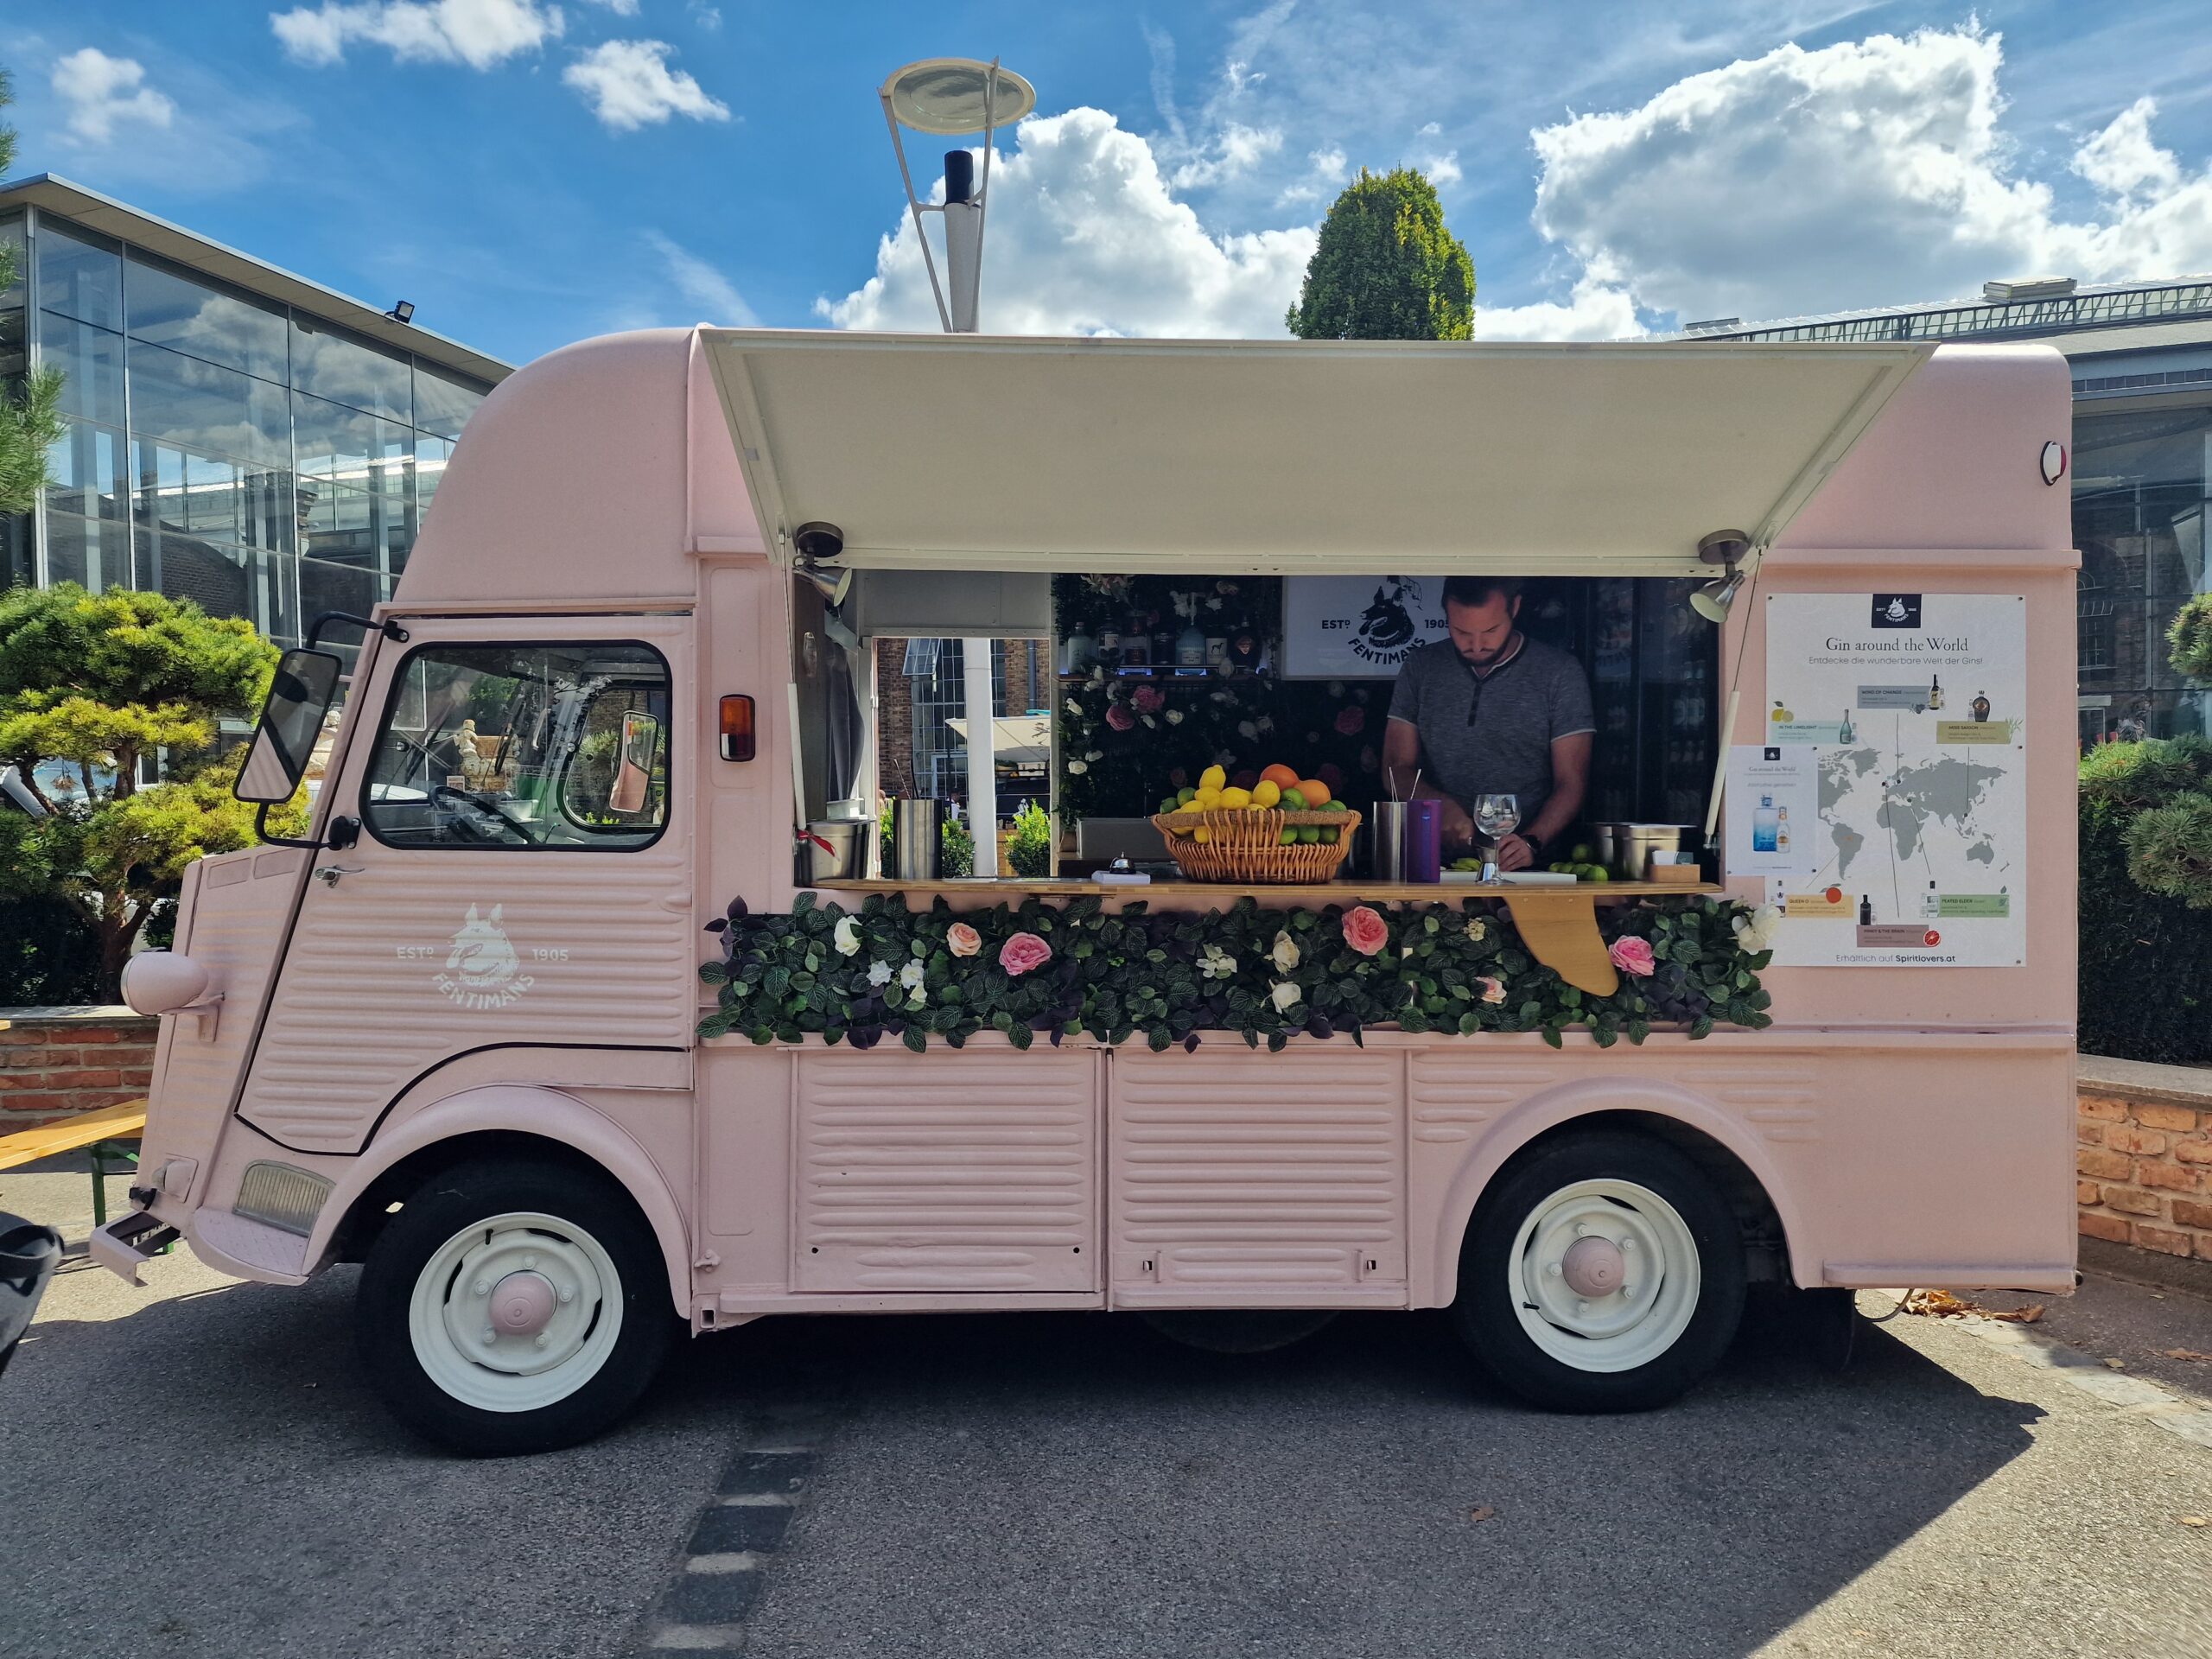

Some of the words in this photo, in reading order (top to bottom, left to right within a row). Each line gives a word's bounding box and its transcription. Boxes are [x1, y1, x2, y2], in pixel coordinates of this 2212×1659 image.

[1826, 638, 1850, 651] Gin
[1855, 638, 1900, 652] around
[1904, 638, 1924, 652] the
[1926, 638, 1968, 652] World
[531, 948, 569, 961] 1905
[1836, 954, 1877, 963] Erhältlich
[1878, 954, 1893, 963] auf
[1896, 954, 1956, 963] Spiritlovers.at
[432, 972, 535, 1010] FENTIMANS
